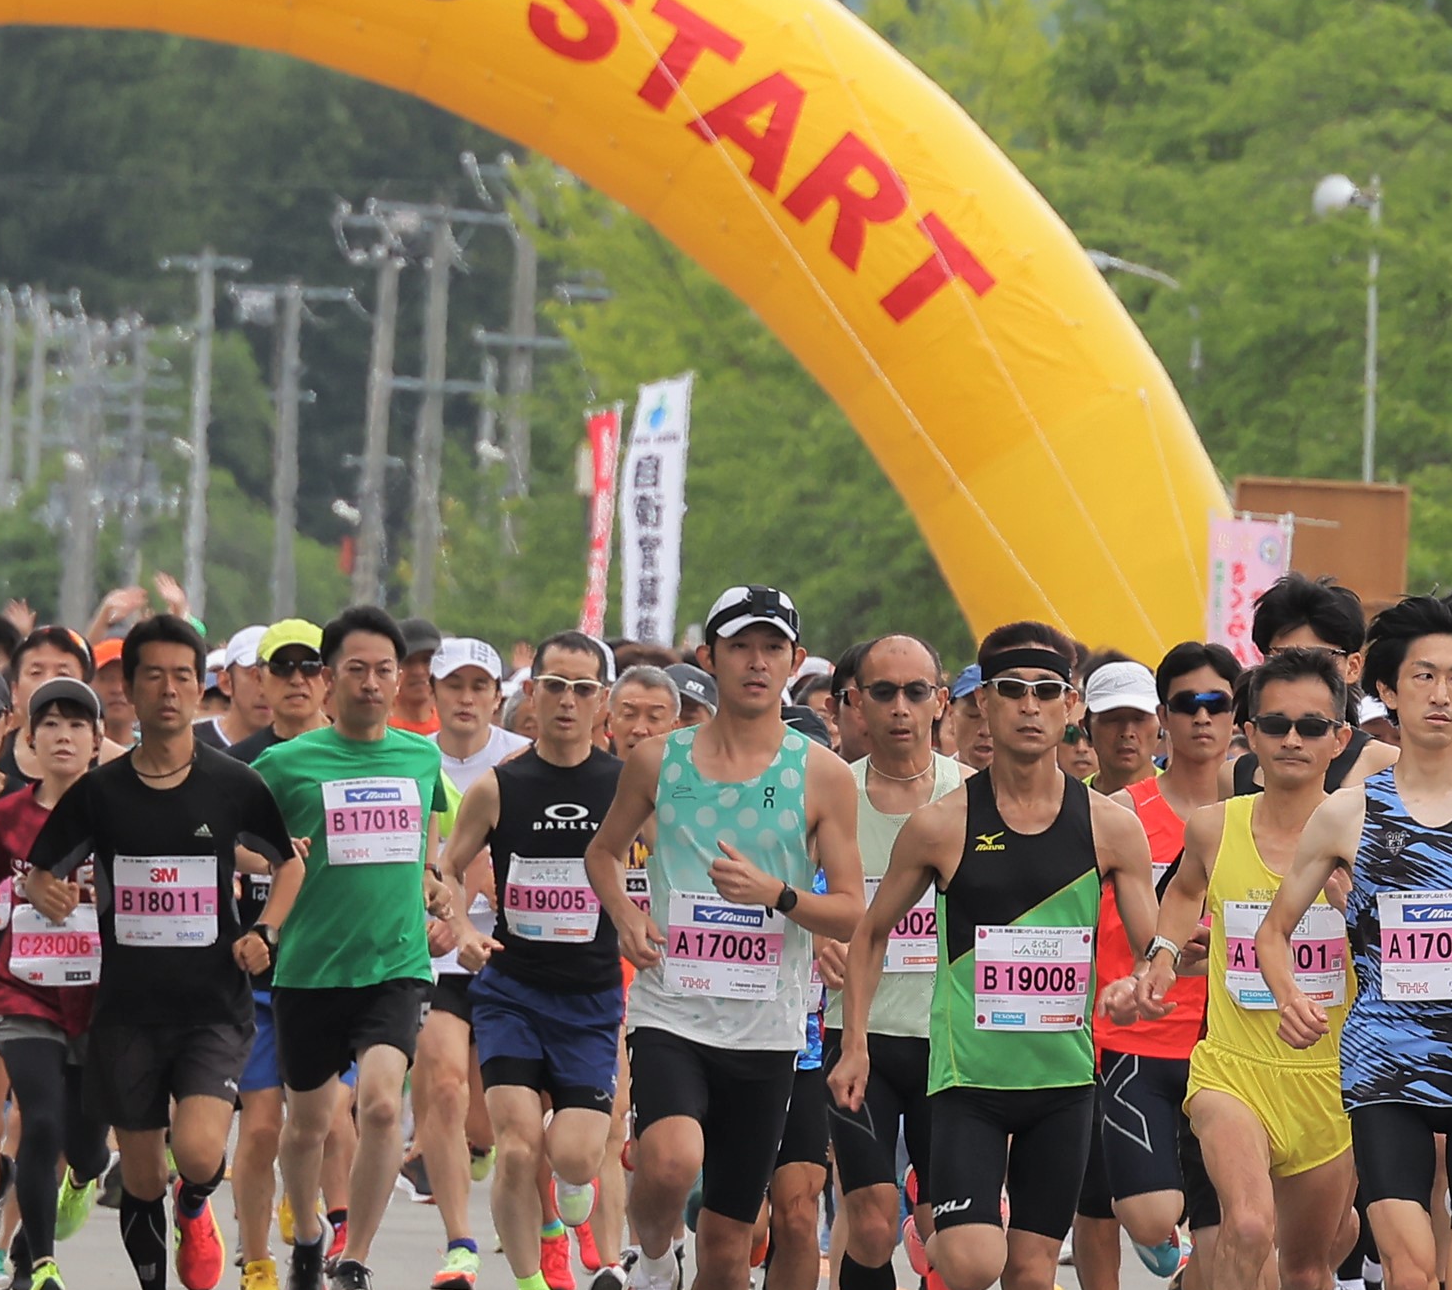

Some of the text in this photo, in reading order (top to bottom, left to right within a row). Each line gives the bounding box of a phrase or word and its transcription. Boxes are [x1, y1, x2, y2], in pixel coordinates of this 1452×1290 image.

[333, 808, 410, 832] B17018
[532, 821, 600, 831] OAKLEY
[150, 867, 179, 883] 3M
[121, 889, 200, 913] B18011
[509, 887, 586, 910] B19005
[18, 934, 92, 956] C23006
[674, 930, 767, 962] A17003
[983, 965, 1077, 992] B19008
